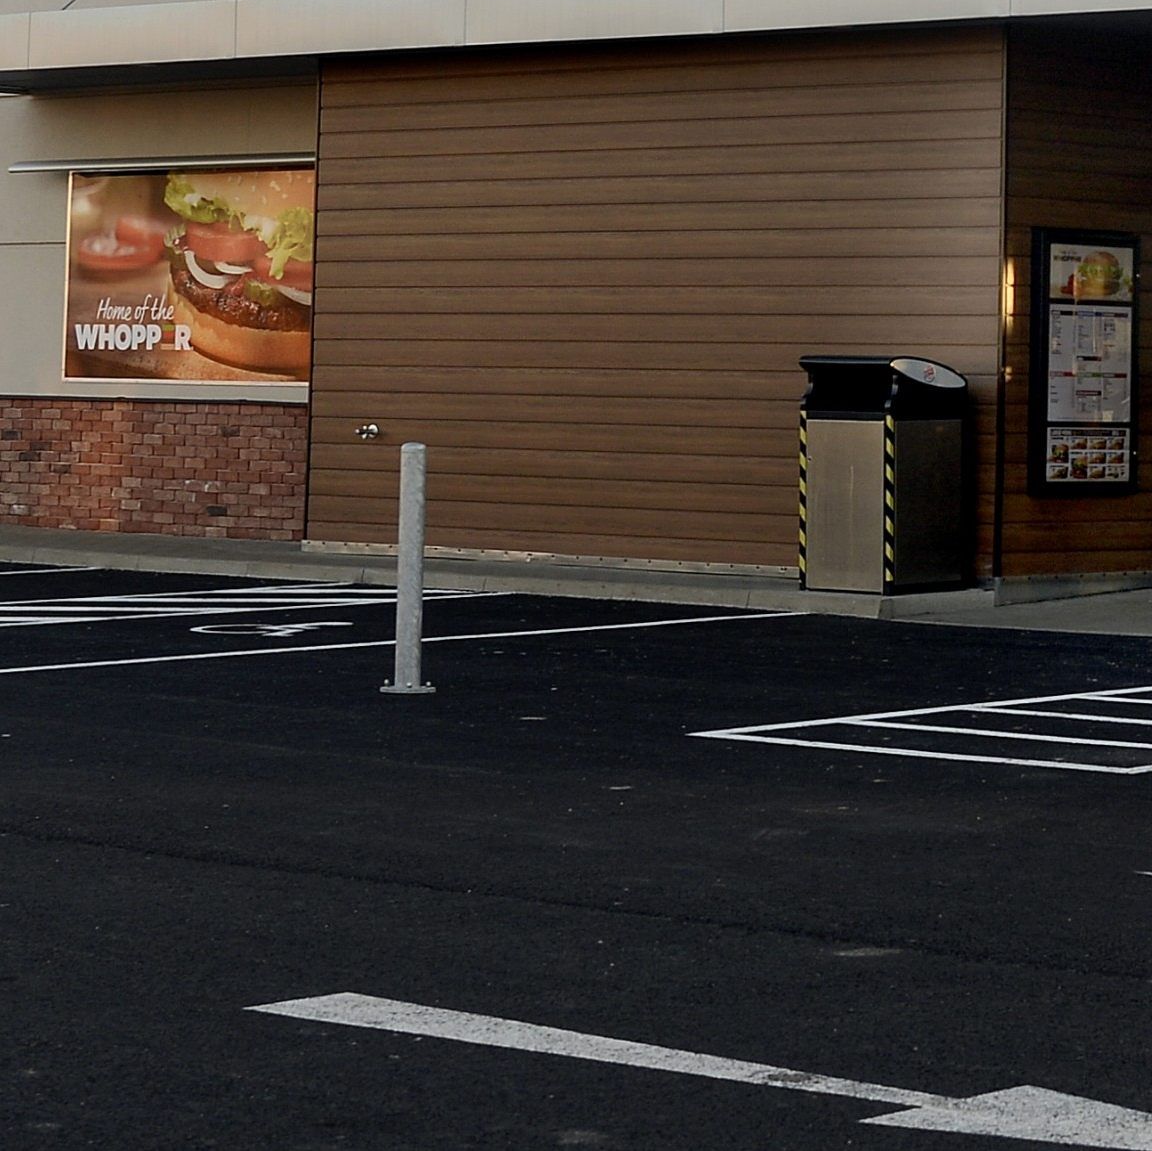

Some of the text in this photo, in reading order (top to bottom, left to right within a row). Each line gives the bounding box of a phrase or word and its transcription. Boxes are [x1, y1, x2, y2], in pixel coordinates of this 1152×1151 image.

[96, 293, 175, 324] Home of the
